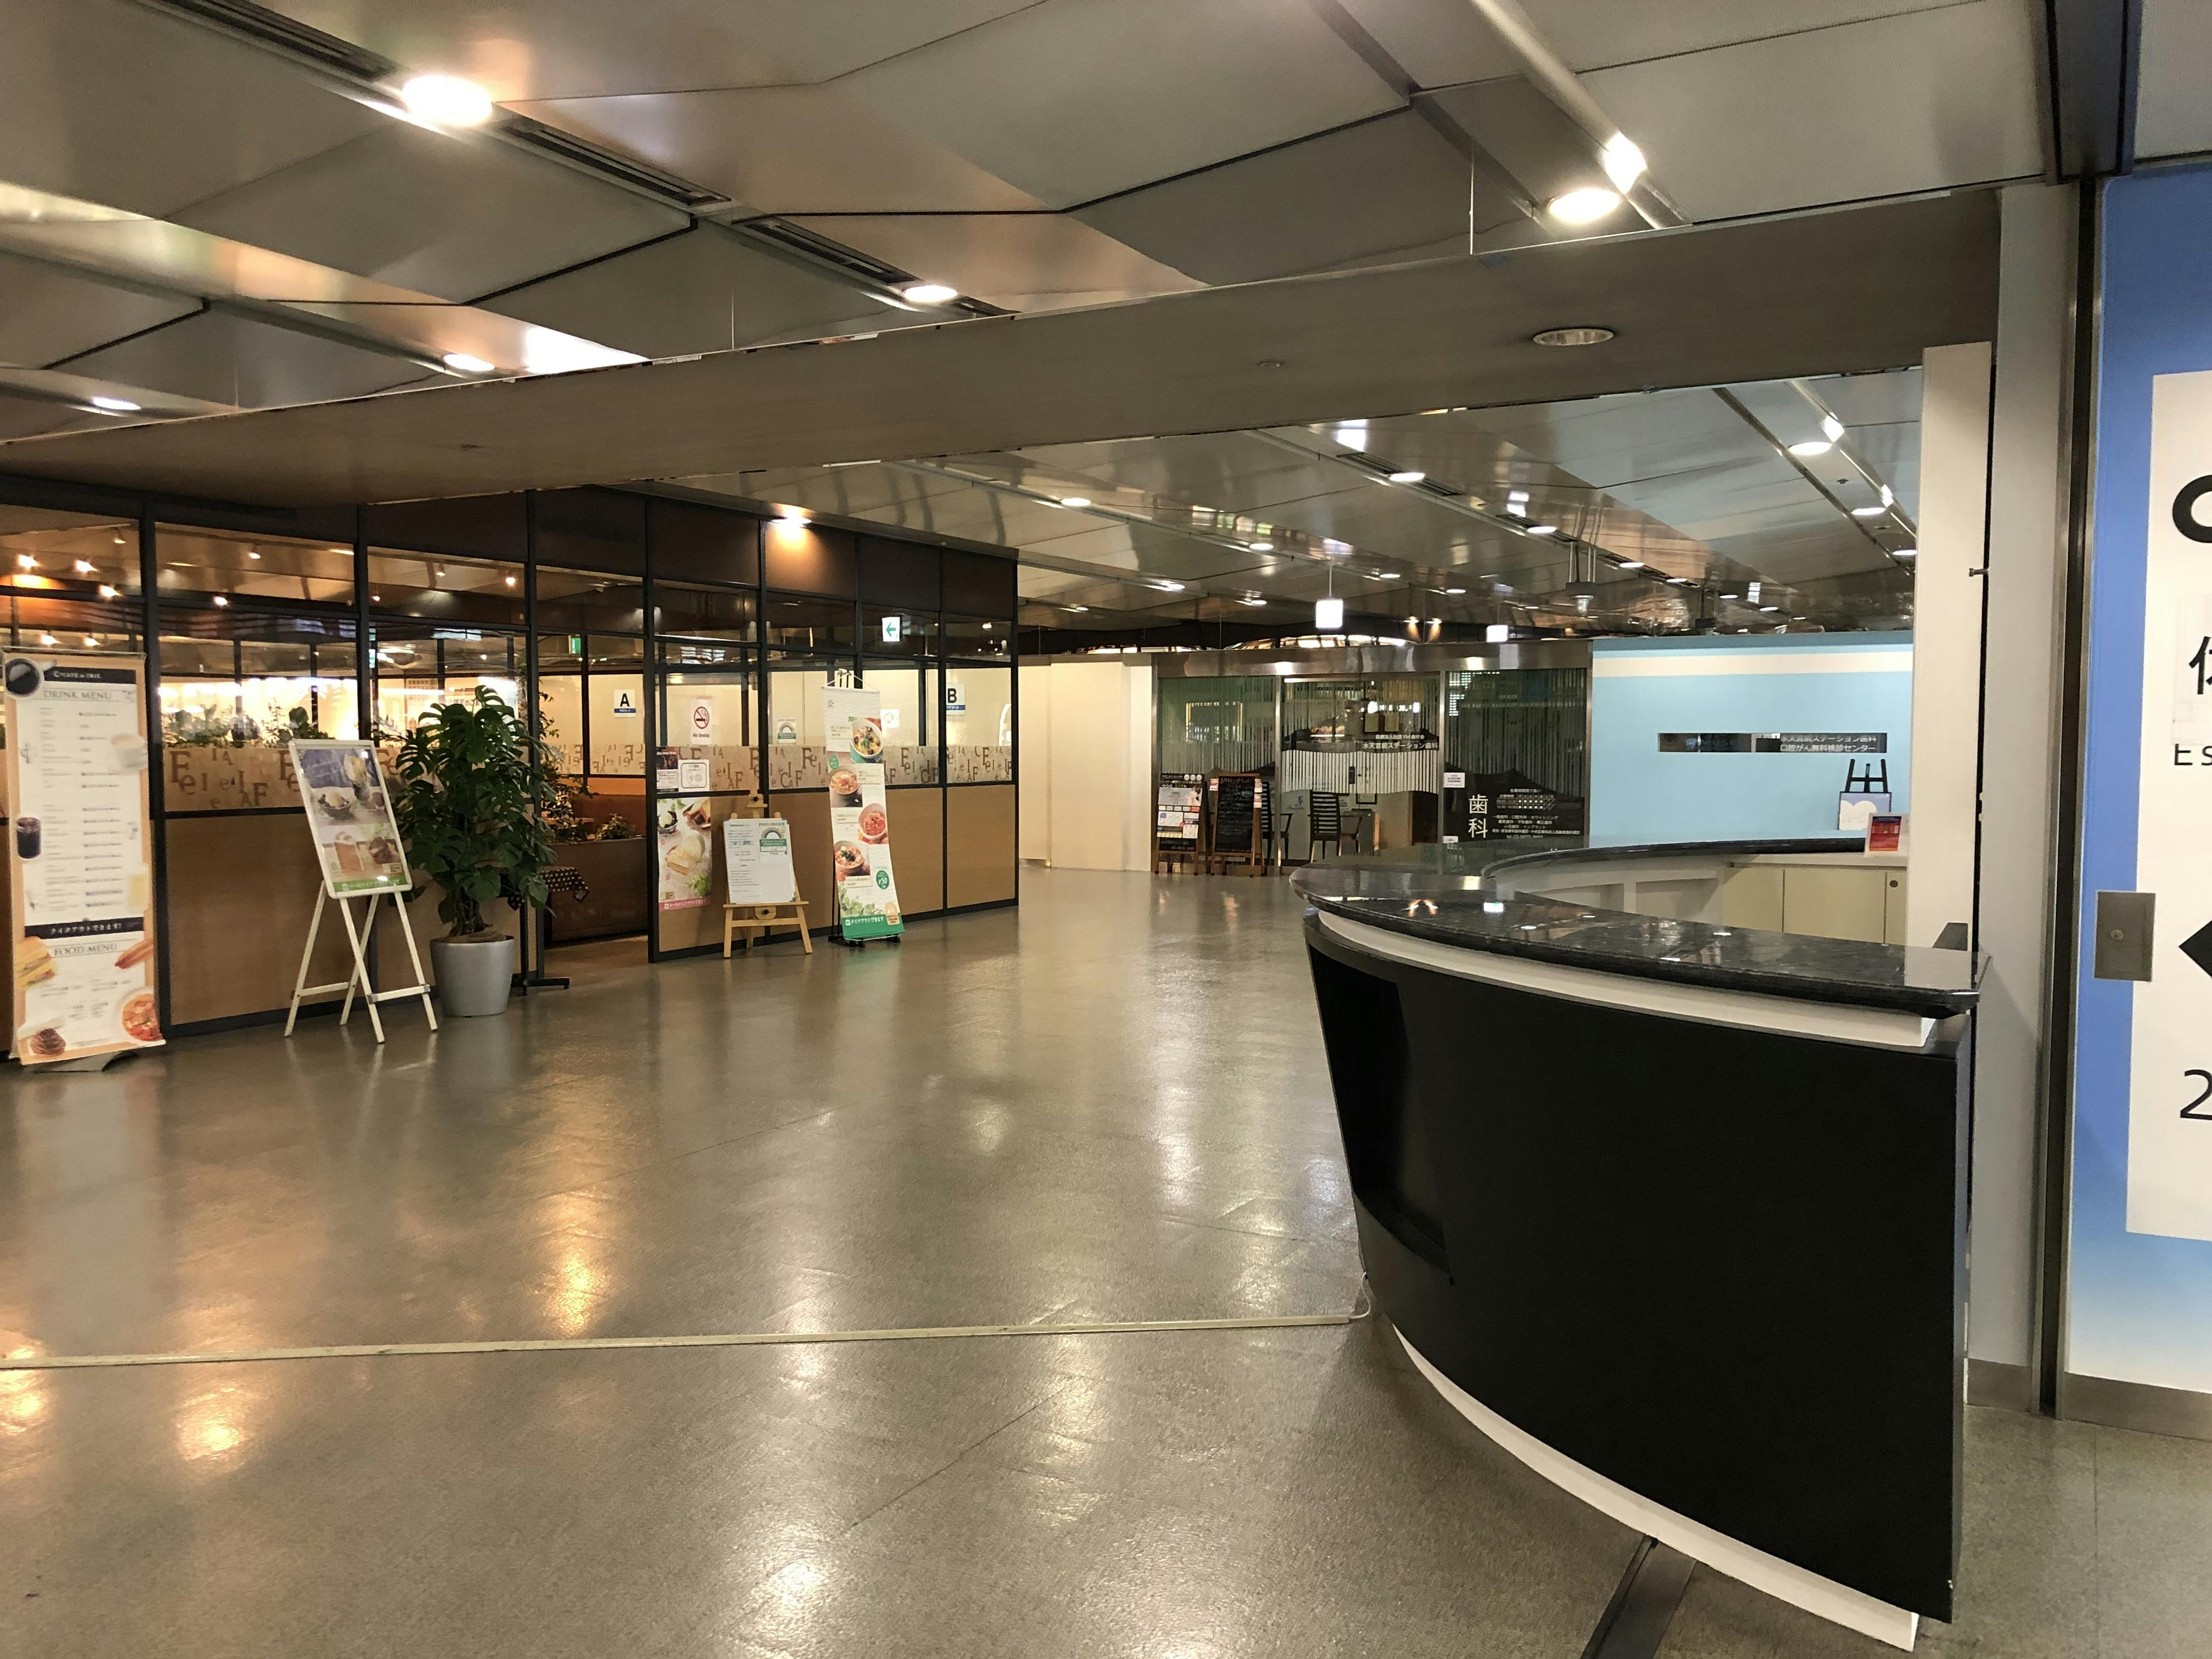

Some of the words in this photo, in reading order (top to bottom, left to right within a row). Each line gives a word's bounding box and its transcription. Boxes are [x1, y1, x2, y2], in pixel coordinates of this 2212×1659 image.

[43, 690, 78, 698] DRINK
[81, 691, 112, 699] MENU
[620, 693, 630, 707] A
[947, 687, 957, 703] B
[1468, 793, 1489, 838] 歯科
[55, 946, 84, 956] FOOD
[88, 944, 118, 952] MENU
